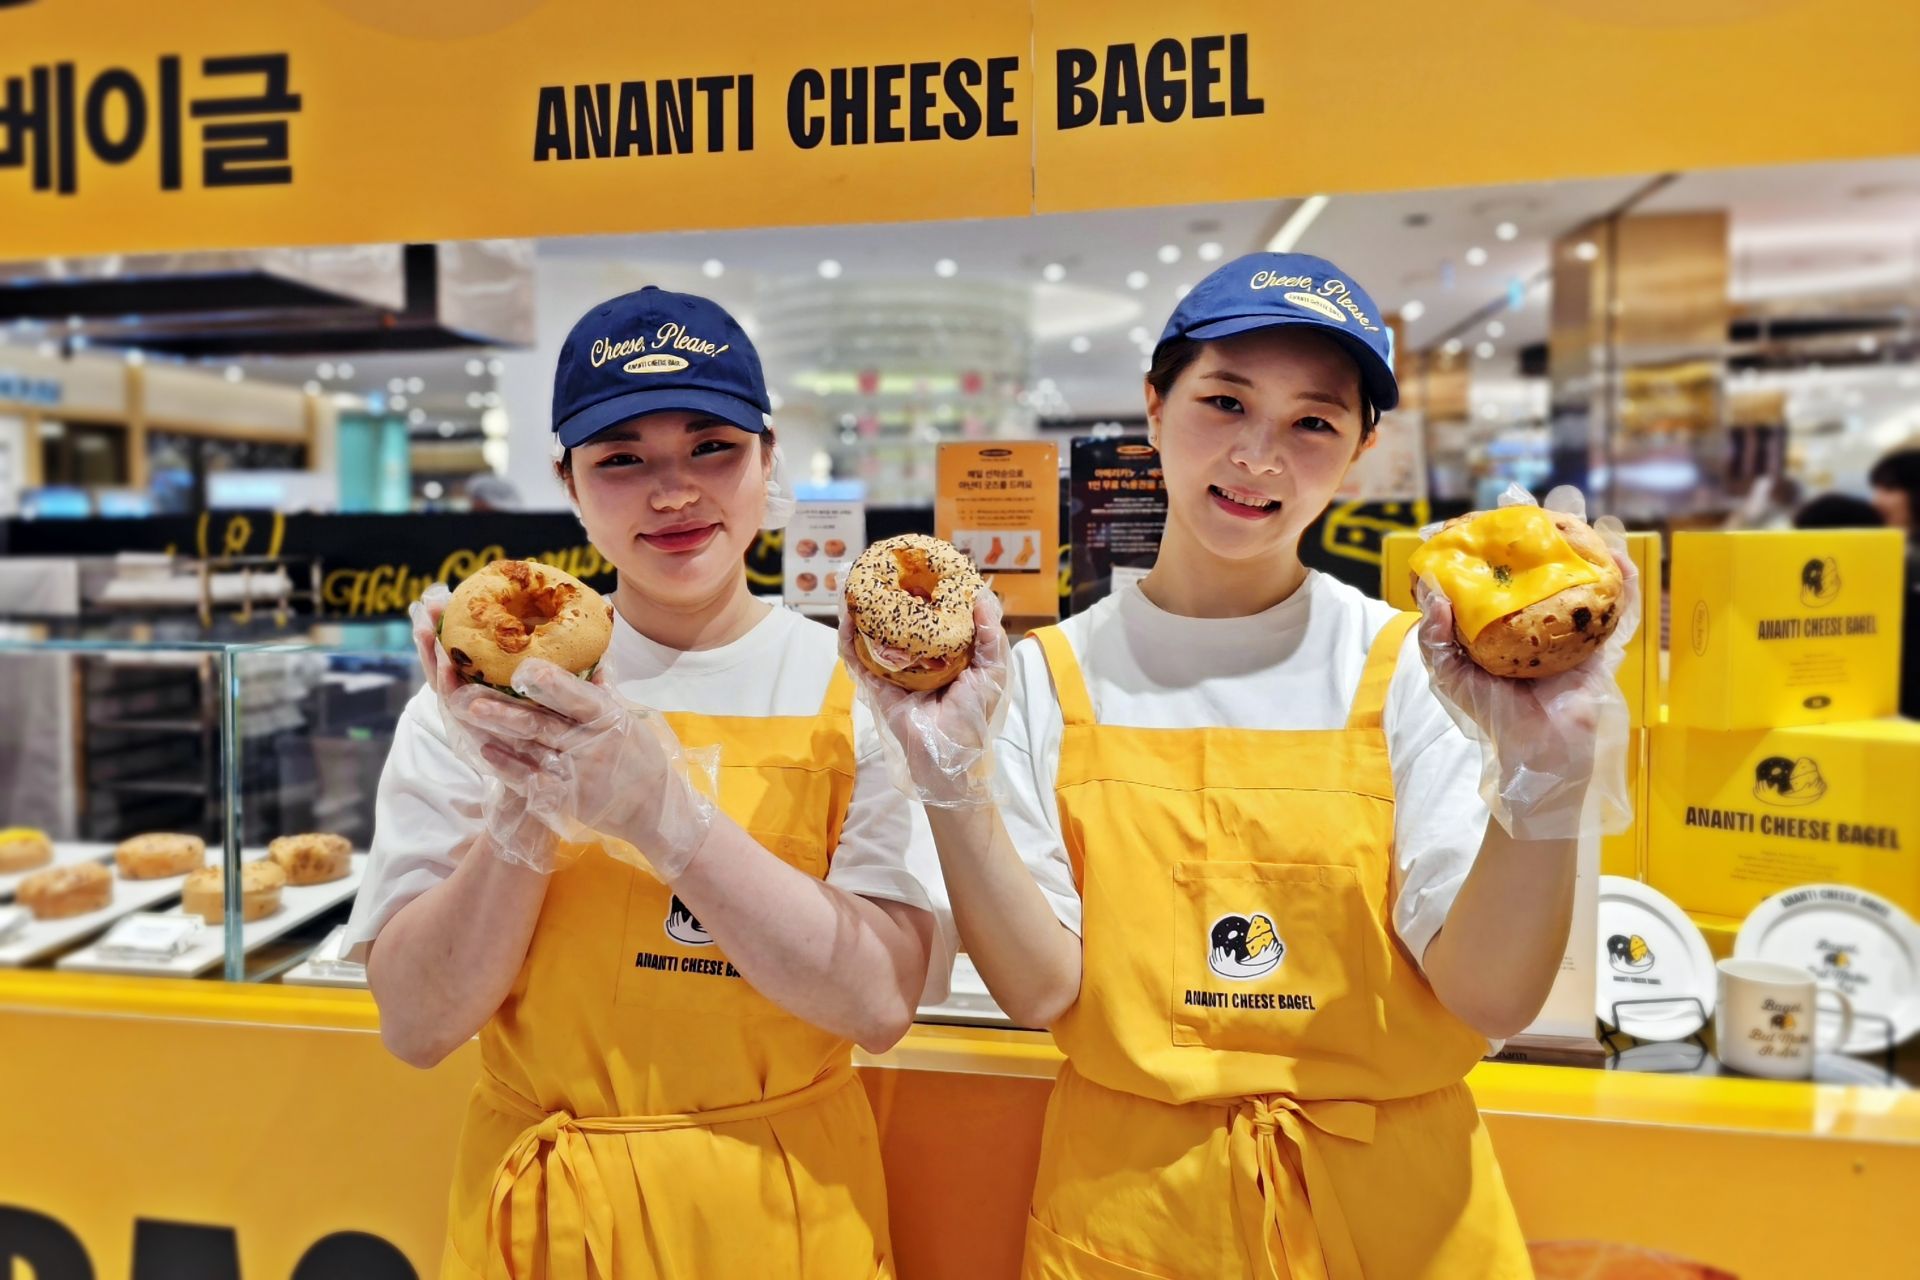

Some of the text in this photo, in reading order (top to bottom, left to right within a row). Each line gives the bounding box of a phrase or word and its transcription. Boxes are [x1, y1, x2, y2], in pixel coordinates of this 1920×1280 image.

[533, 34, 1264, 161] ANANTI CHEESE BAGEL
[0, 53, 302, 195] 베이글
[1317, 279, 1380, 332] Please!
[651, 322, 730, 358] Please!
[1758, 615, 1878, 640] ANANTI CHEESE BAGEL
[1685, 806, 1901, 850] ANANTI CHEESE BAGEL
[635, 952, 679, 972] ANANTI
[681, 957, 724, 976] CHEESE
[1184, 989, 1316, 1011] ANANTI CHEESE BAGEL
